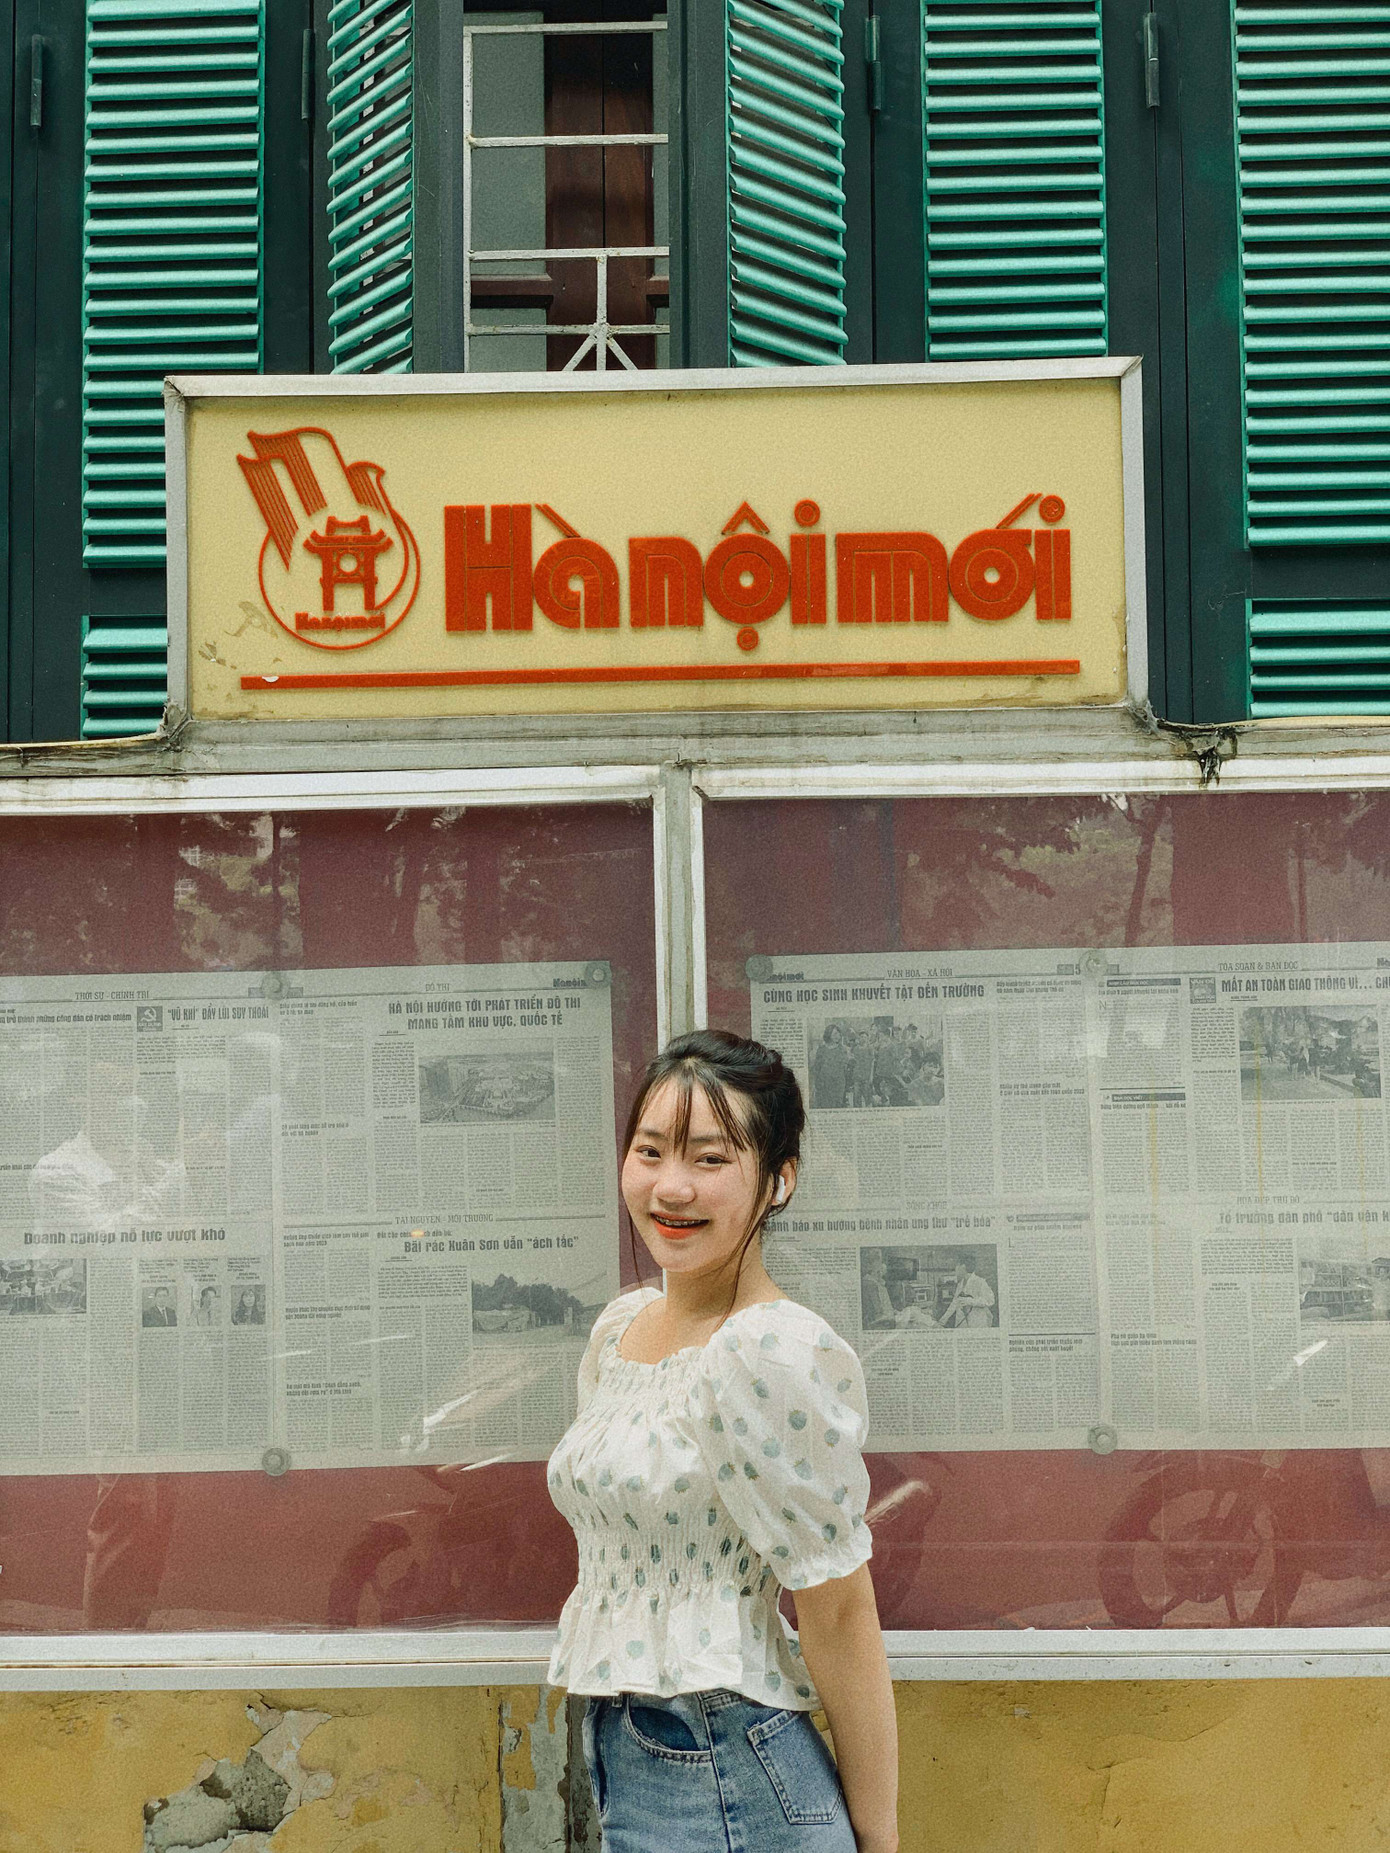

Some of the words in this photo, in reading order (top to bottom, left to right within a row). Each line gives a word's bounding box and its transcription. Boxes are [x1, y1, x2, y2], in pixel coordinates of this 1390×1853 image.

[445, 493, 1072, 652] Hànộimới
[1222, 975, 1242, 992] MẤT
[1245, 979, 1258, 992] AN
[1260, 976, 1286, 991] TOÀN
[1288, 978, 1312, 990] GIAO
[1314, 976, 1346, 990] THÔNG
[1348, 974, 1372, 990] VÌ...
[1376, 976, 1390, 989] CH
[764, 988, 792, 1004] CÙNG
[796, 989, 818, 1004] HỌC
[822, 988, 848, 1002] SINH
[852, 983, 892, 1000] KHUYẾT
[894, 986, 914, 1002] TẬT
[918, 983, 938, 999] ĐẾN
[942, 983, 984, 998] TRƯỜNG
[388, 1001, 402, 1014] HÀ
[406, 1001, 423, 1016] NỘI
[427, 998, 462, 1013] HƯỚNG
[465, 998, 482, 1012] TỚI
[485, 997, 510, 1011] PHÁT
[514, 994, 543, 1010] TRIỂN
[547, 996, 562, 1009] ĐÔ
[565, 997, 580, 1010] THỊ
[408, 1016, 438, 1030] MANG
[442, 1014, 464, 1029] TẦM
[468, 1015, 489, 1028] KHU
[492, 1014, 516, 1029] VỰC,
[520, 1011, 548, 1026] QUỐC
[550, 1010, 563, 1026] TẾ
[24, 1232, 66, 1245] Doanh
[70, 1230, 116, 1246] nghiệp
[120, 1228, 137, 1243] nỗ
[142, 1228, 162, 1244] lực
[166, 1228, 196, 1244] vượt
[200, 1228, 226, 1241] khó
[404, 1239, 422, 1252] Bãi
[425, 1238, 444, 1252] rác
[449, 1238, 476, 1252] Xuân
[479, 1238, 500, 1250] Sơn
[504, 1235, 523, 1250] vẫn
[527, 1236, 552, 1249] "ách
[556, 1234, 579, 1248] tắc"
